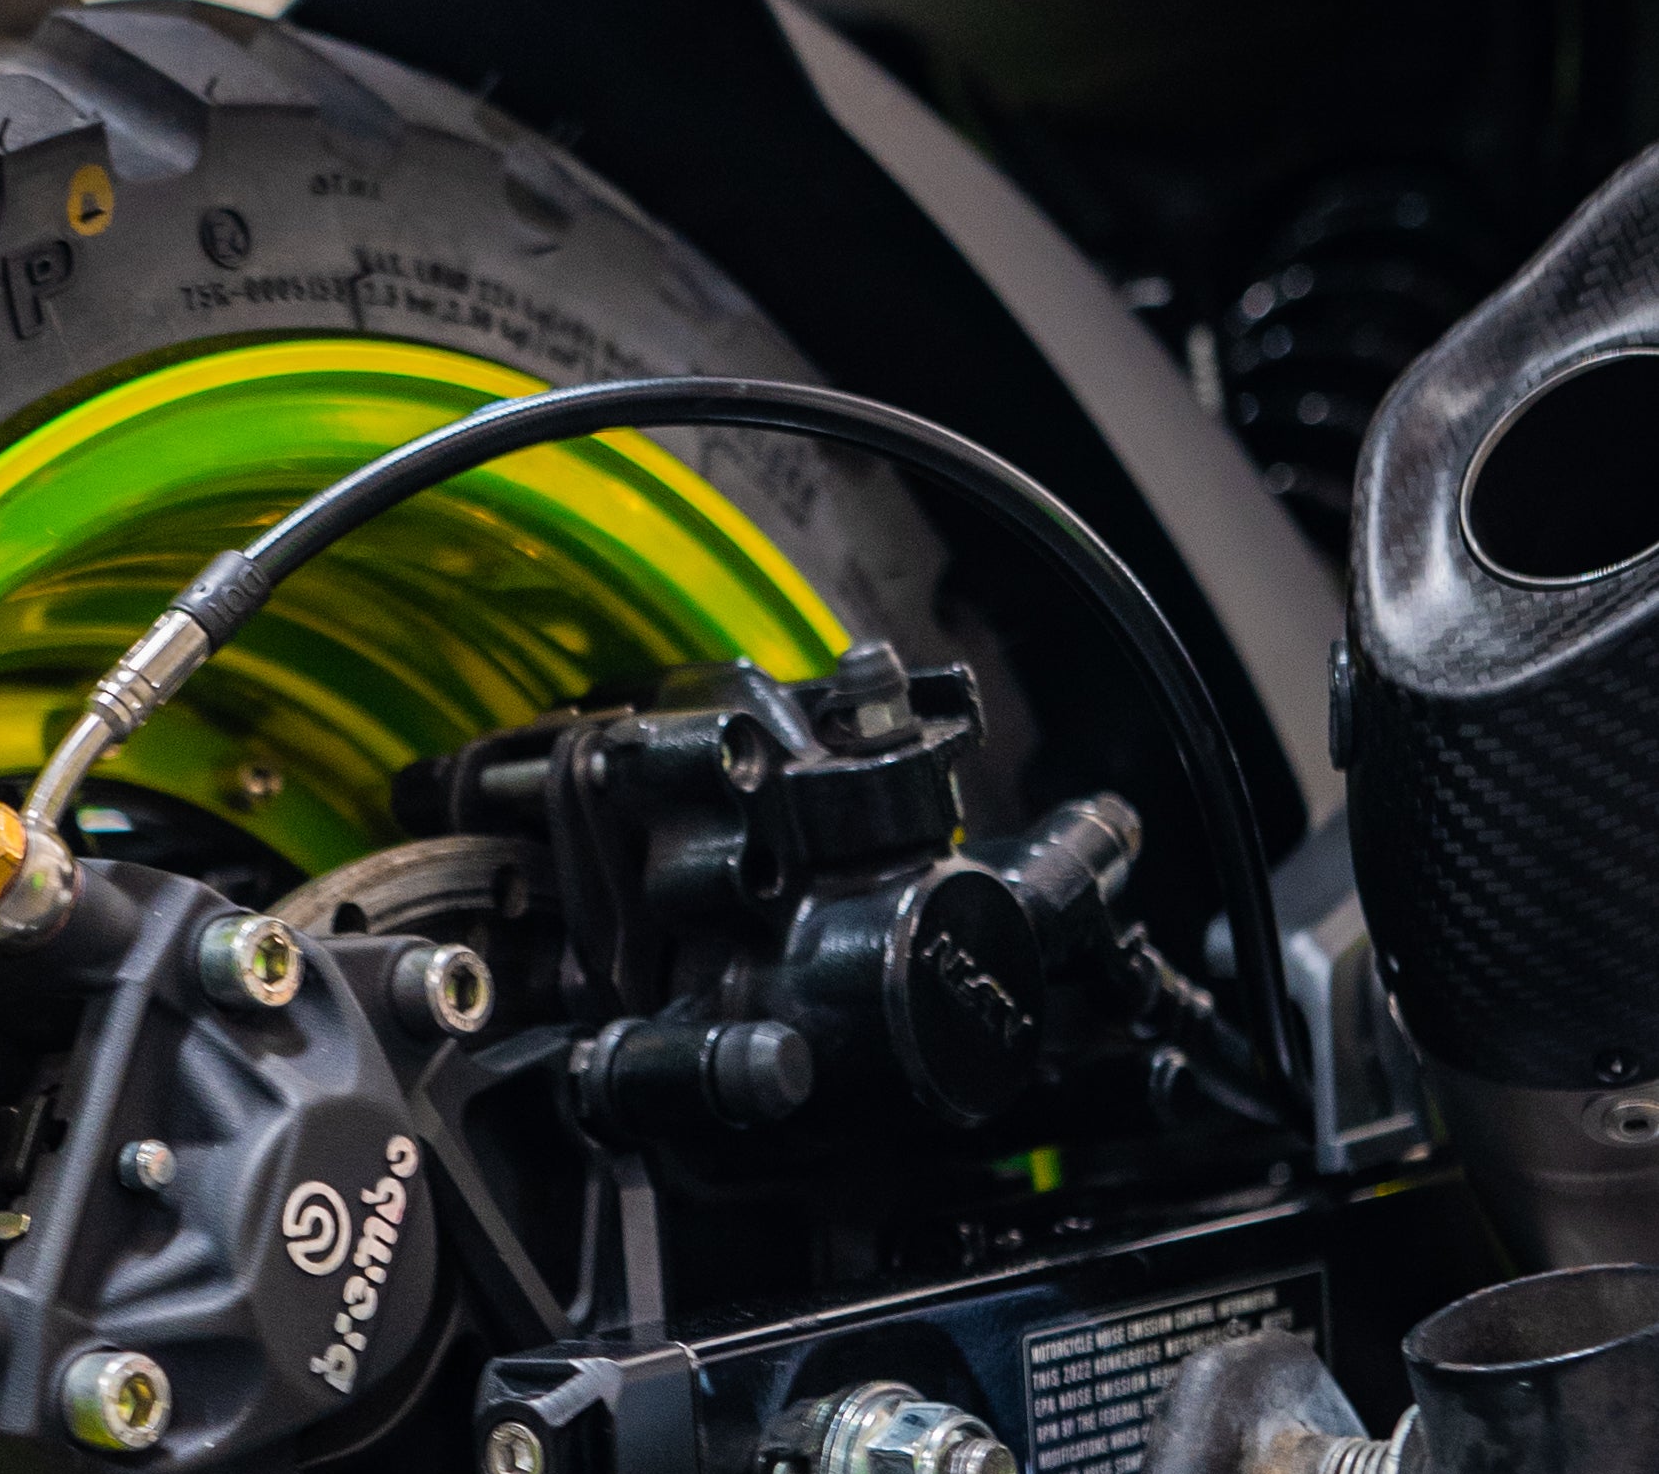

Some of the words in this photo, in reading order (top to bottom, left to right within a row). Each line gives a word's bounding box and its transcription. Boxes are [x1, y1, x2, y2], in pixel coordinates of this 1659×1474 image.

[309, 1134, 419, 1394] brembo
[1031, 1334, 1093, 1364] MOTORCYCLE
[1096, 1325, 1124, 1348] NOISE
[1127, 1313, 1172, 1341] EMISSION
[1033, 1368, 1058, 1390] THIS
[1035, 1396, 1055, 1417] EPA
[1059, 1386, 1091, 1411] NOISE
[1095, 1372, 1146, 1401] EMISSION
[1036, 1420, 1058, 1442] RPM
[1077, 1411, 1096, 1432] THE
[1099, 1400, 1140, 1426] FEDERAL
[1038, 1436, 1107, 1469] MODIFICATIONS
[1111, 1427, 1139, 1449] WHICH
